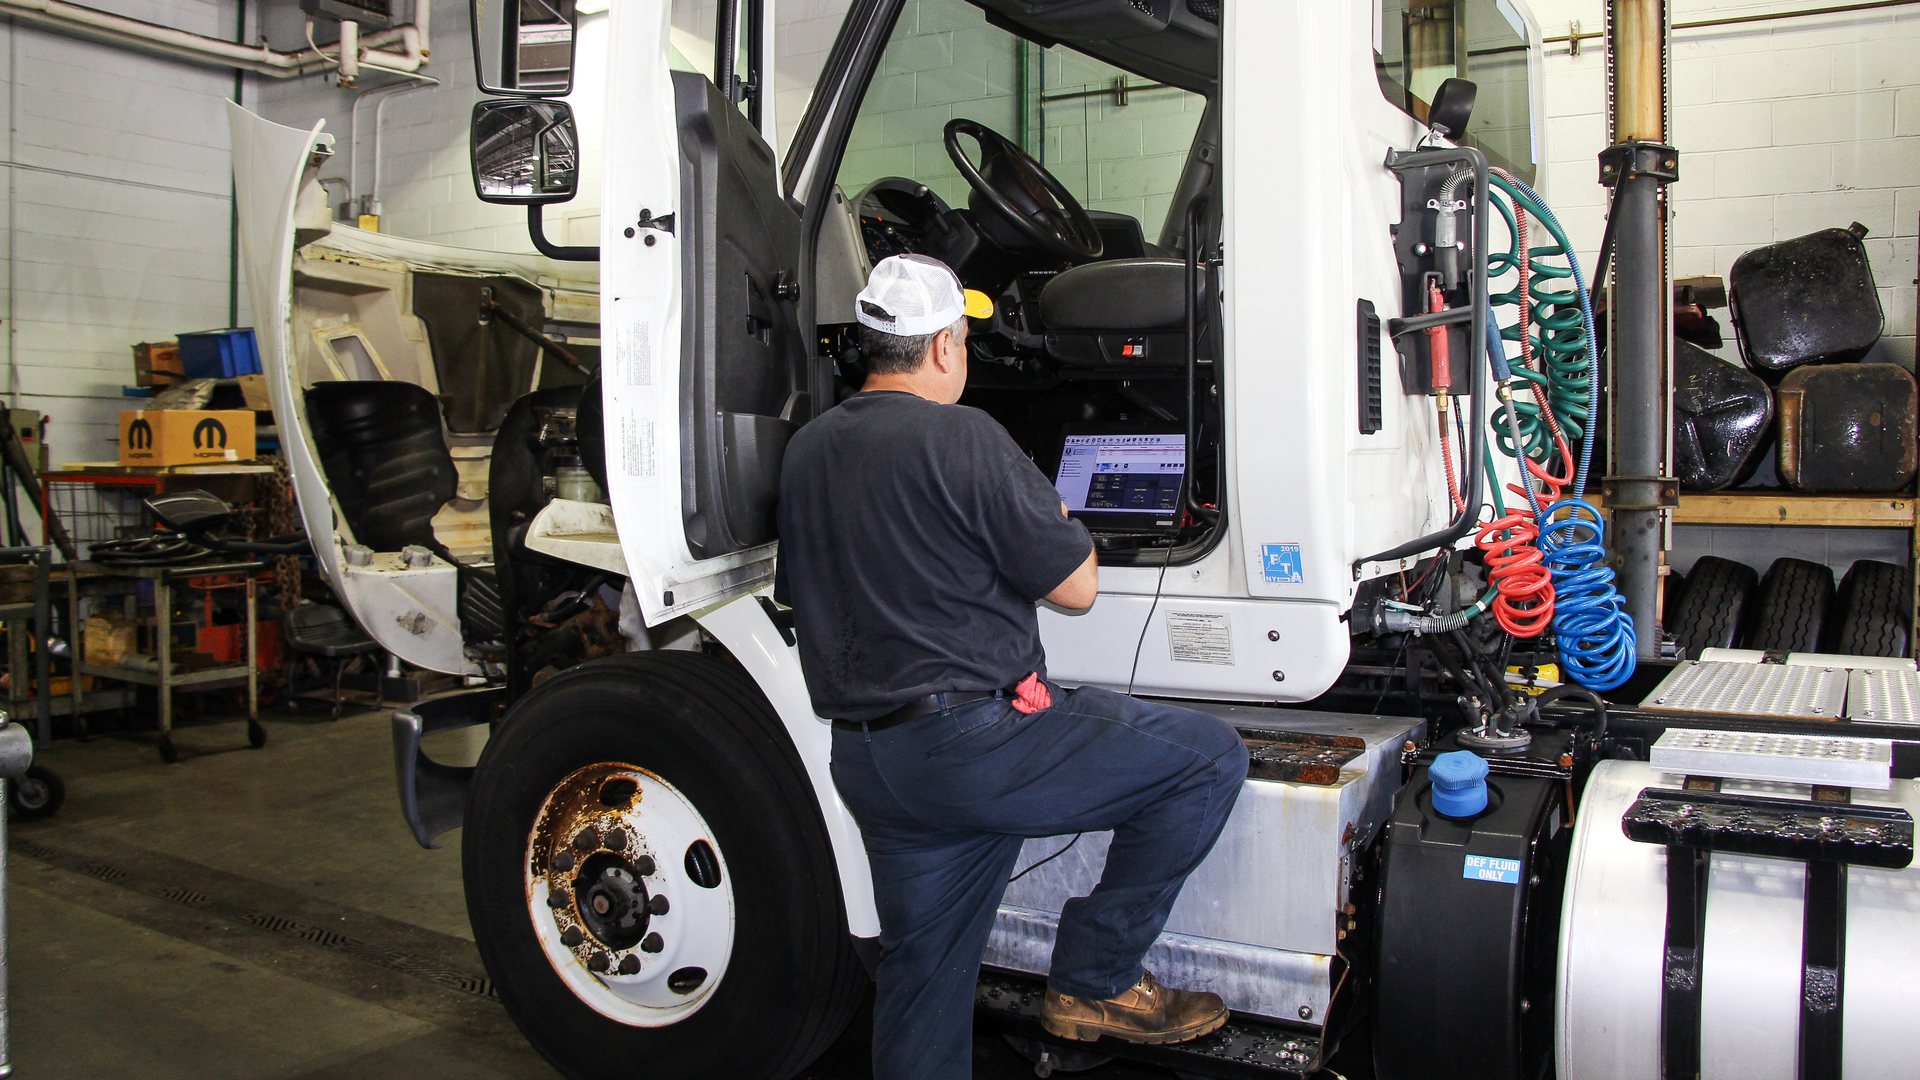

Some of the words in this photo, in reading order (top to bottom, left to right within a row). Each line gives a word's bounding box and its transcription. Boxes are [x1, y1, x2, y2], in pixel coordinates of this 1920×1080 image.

[1467, 856, 1487, 868] DEF
[1489, 859, 1519, 871] FLUID
[1478, 869, 1505, 880] ONLY
